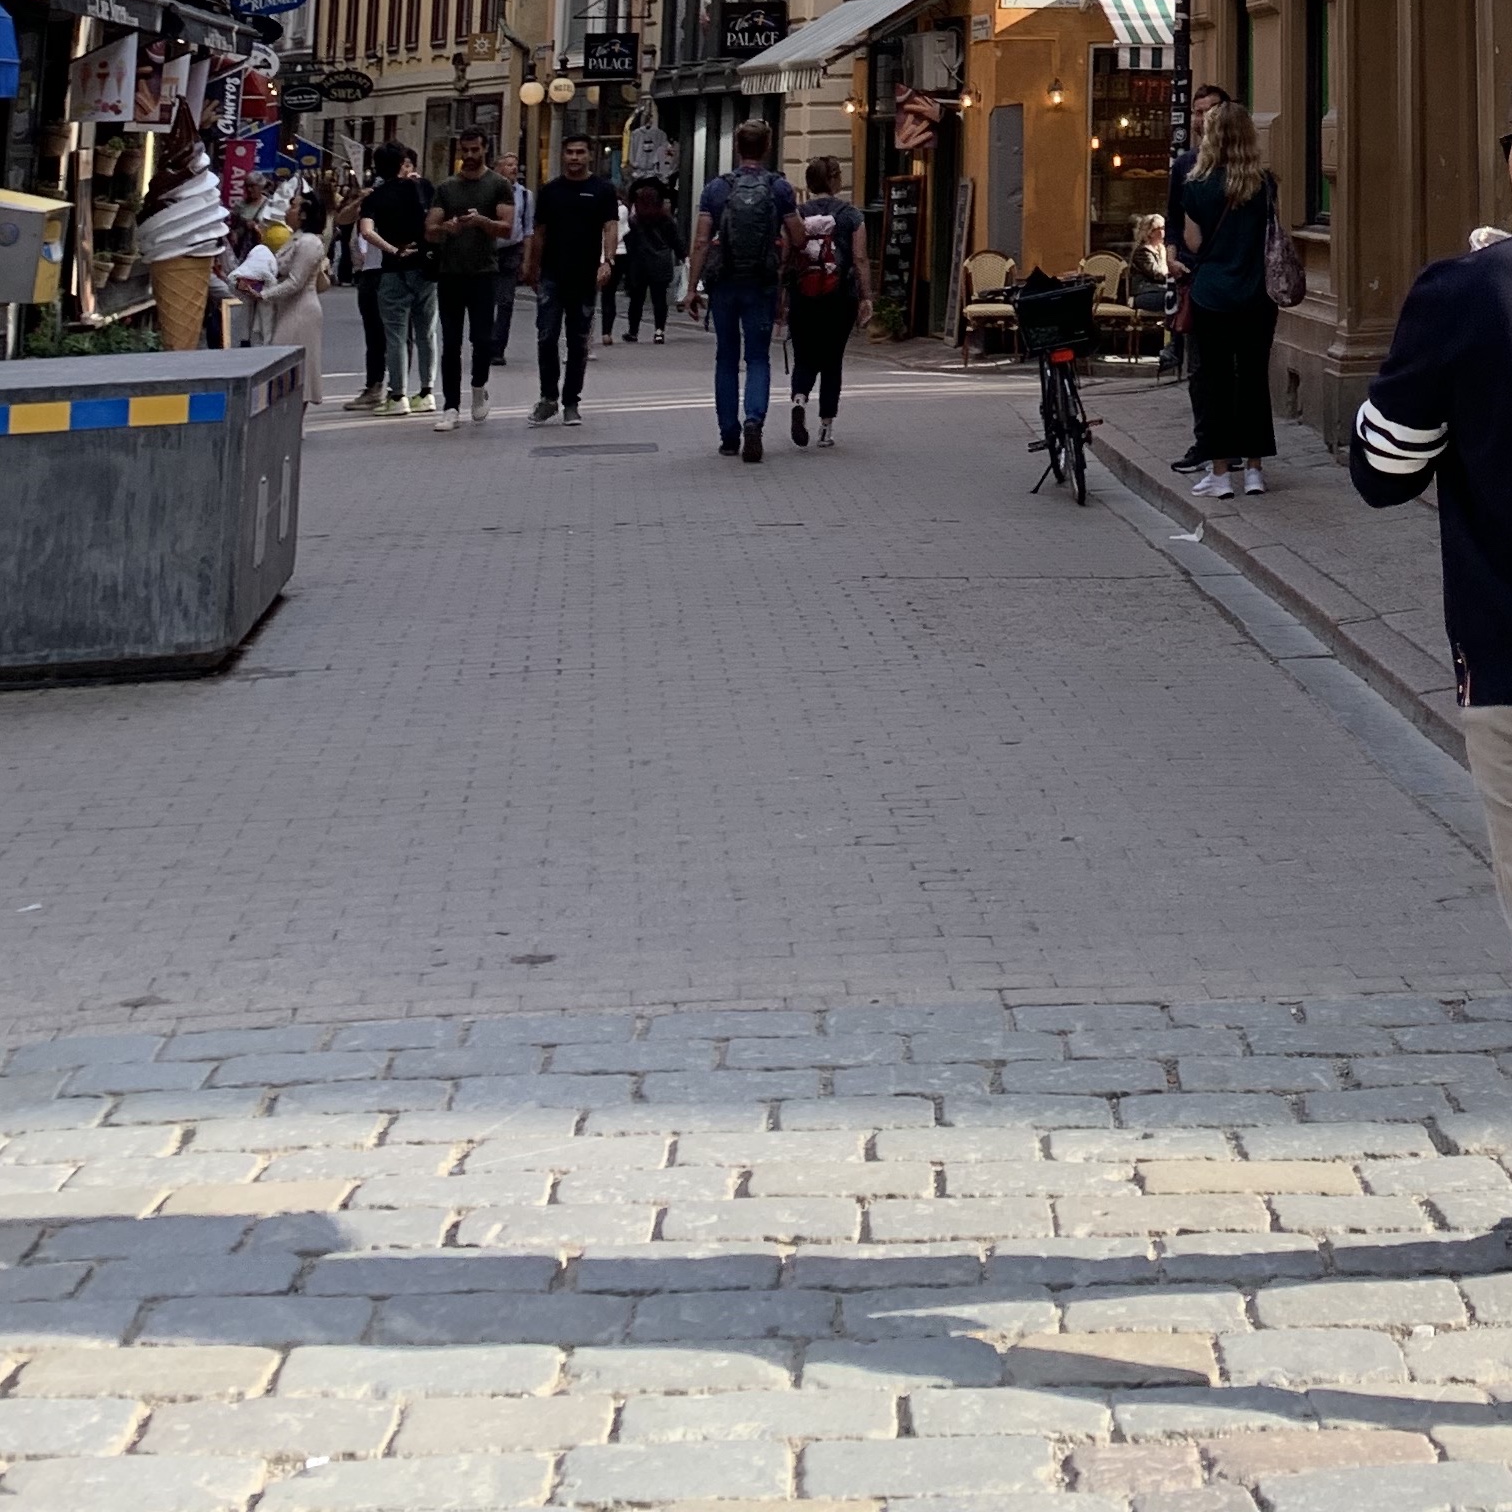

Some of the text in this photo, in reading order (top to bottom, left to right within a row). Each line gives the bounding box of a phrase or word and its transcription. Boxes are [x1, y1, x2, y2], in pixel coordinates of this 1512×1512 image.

[727, 31, 780, 46] PALACE
[588, 57, 633, 70] PALACE
[217, 77, 240, 134] Churros
